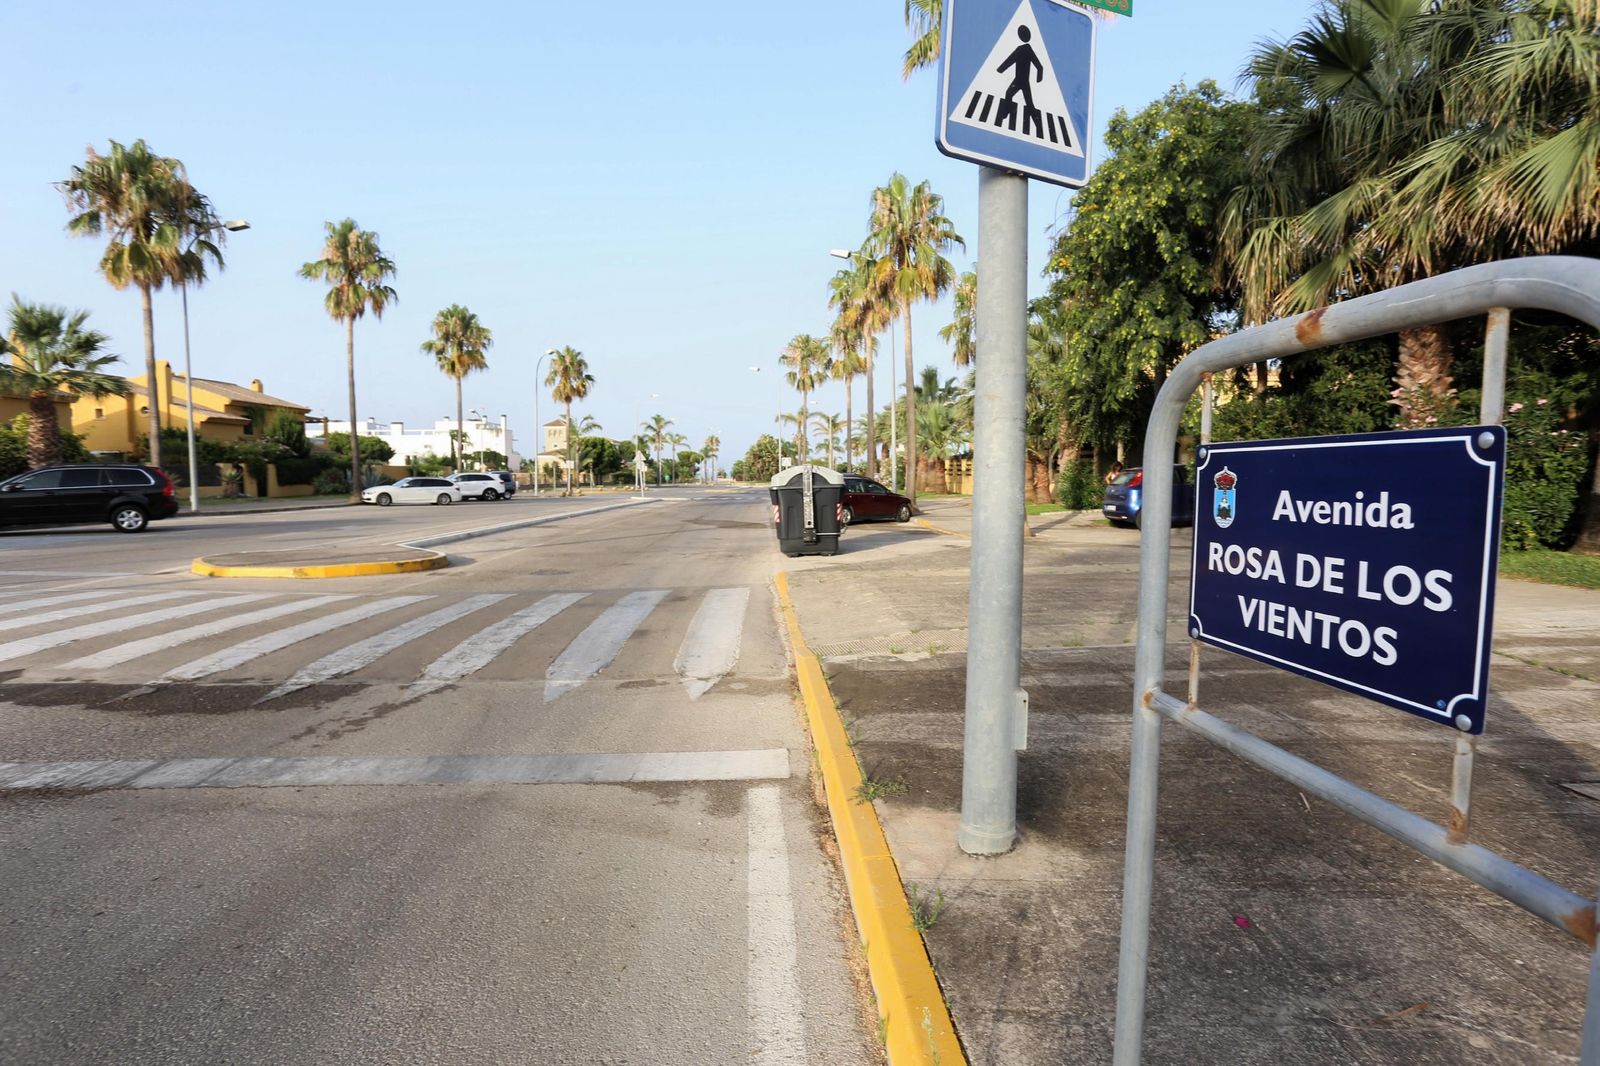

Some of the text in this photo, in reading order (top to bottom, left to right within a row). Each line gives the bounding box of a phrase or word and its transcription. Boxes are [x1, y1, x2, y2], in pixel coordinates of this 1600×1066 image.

[1272, 490, 1415, 530] Avenida
[1208, 542, 1453, 612] ROSA DE LOS
[1238, 595, 1398, 666] VIENTOS
